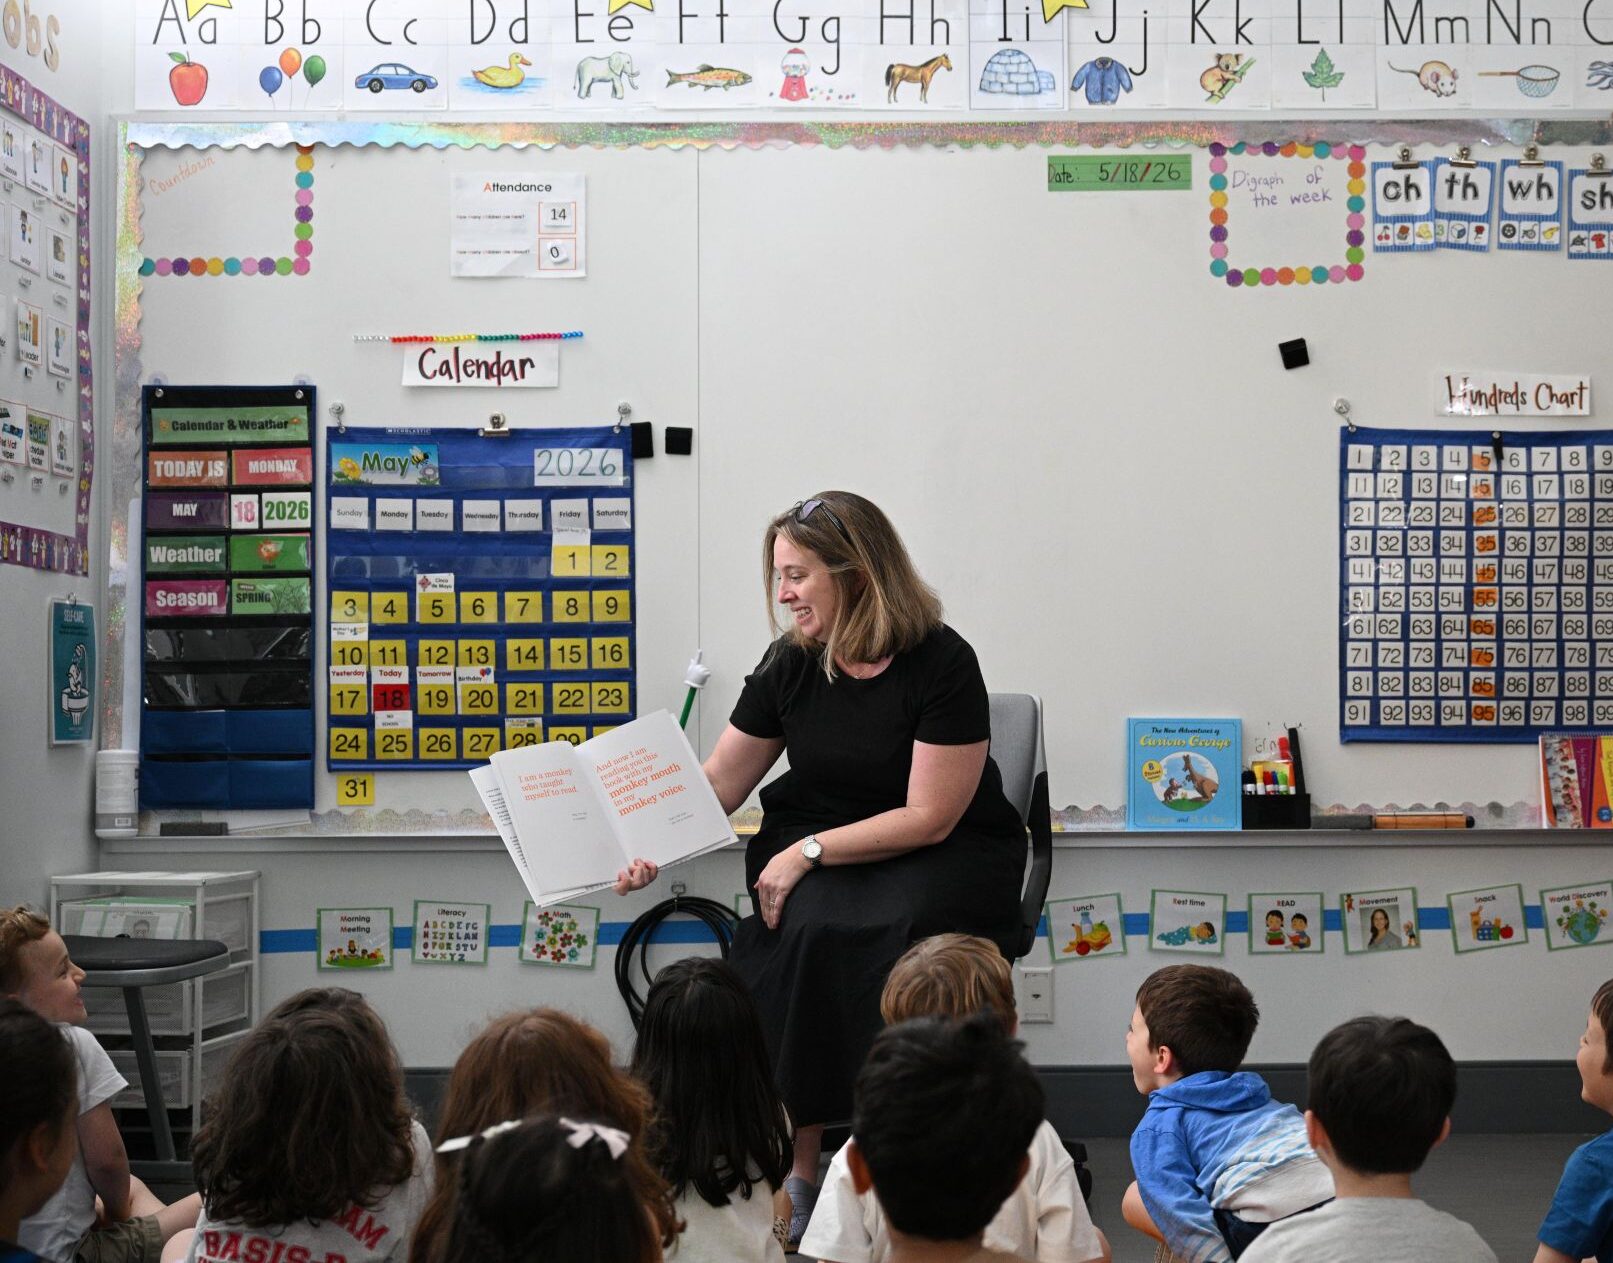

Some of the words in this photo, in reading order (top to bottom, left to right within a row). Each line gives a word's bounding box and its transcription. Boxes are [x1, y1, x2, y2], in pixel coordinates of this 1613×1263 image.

[149, 157, 215, 196] Countdown
[1048, 163, 1080, 183] Date:
[1099, 162, 1181, 183] 5/18/26
[1232, 170, 1284, 192] Digraph
[1306, 164, 1324, 184] of
[483, 182, 552, 192] Attendance
[1383, 173, 1422, 202] ch
[1445, 172, 1479, 201] th
[1508, 173, 1554, 202] wh
[1253, 193, 1278, 208] the
[1290, 188, 1332, 205] week
[1581, 182, 1613, 210] sh
[551, 208, 567, 221] 14
[550, 246, 559, 258] 0
[418, 346, 535, 386] Calendar
[1445, 375, 1527, 414] Hundreds
[1535, 381, 1588, 411] Chart
[172, 420, 224, 431] Calendar
[227, 420, 237, 430] &
[238, 420, 288, 430] Weather
[154, 460, 204, 478] TODAY
[208, 460, 224, 477] IS
[248, 460, 298, 474] MONDAY
[362, 452, 409, 477] May
[538, 448, 616, 476] 2026
[172, 503, 198, 517] MAY
[234, 501, 256, 523] 18
[264, 500, 309, 520] 2026
[380, 510, 408, 520] Monday
[421, 510, 448, 520] Tuesday
[464, 512, 499, 520] Wednesday
[508, 512, 539, 520] Thursday
[560, 510, 581, 518] Friday
[596, 510, 628, 518] Saturday
[1350, 536, 1368, 550] 31
[1378, 536, 1400, 550] 32
[1410, 536, 1431, 550] 33
[1442, 536, 1463, 550] 34
[1476, 536, 1496, 550] 35
[1507, 536, 1527, 551] 36
[1536, 536, 1556, 550] 37
[1566, 536, 1586, 550] 38
[150, 546, 222, 564] Weather
[569, 552, 576, 570] 1
[604, 553, 617, 570] 2
[156, 590, 218, 607] Season
[236, 592, 271, 603] SPRING
[344, 598, 356, 617] 3
[383, 599, 396, 617] 4
[432, 600, 444, 618] 5
[472, 599, 485, 617] 6
[517, 598, 529, 616] 7
[566, 598, 578, 616] 8
[606, 598, 618, 614] 9
[338, 647, 362, 666] 10
[378, 646, 398, 664] 11
[424, 646, 448, 664] 12
[465, 646, 489, 664] 13
[514, 646, 538, 664] 14
[557, 645, 582, 663] 15
[598, 644, 623, 662] 16
[379, 670, 402, 678] Today
[336, 690, 360, 708] 17
[380, 690, 404, 708] 18
[424, 690, 448, 708] 19
[468, 690, 493, 708] 20
[514, 690, 537, 707] 21
[558, 690, 584, 708] 22
[598, 688, 622, 706] 23
[1383, 705, 1404, 720] 92
[1412, 705, 1433, 720] 93
[1442, 705, 1464, 720] 94
[1502, 705, 1522, 720] 96
[1532, 705, 1554, 720] 97
[1565, 705, 1586, 720] 98
[336, 735, 360, 752] 24
[382, 734, 407, 752] 25
[426, 734, 452, 752] 26
[470, 734, 495, 752] 27
[512, 734, 537, 748] 28
[1139, 735, 1186, 748] Curious
[1188, 735, 1231, 752] George
[594, 760, 612, 772] And
[613, 753, 629, 764] now
[634, 746, 647, 756] am
[600, 765, 630, 782] reading
[630, 760, 644, 771] you
[643, 752, 658, 762] this
[544, 768, 573, 778] monkey
[604, 778, 622, 790] book
[624, 770, 640, 780] with
[642, 763, 654, 774] my
[610, 776, 648, 799] monkey
[650, 762, 682, 781] mouth
[345, 780, 366, 798] 31
[522, 783, 538, 792] who
[540, 778, 564, 788] taught
[525, 788, 550, 801] myself
[552, 788, 560, 796] to
[614, 798, 622, 807] in
[624, 794, 635, 804] my
[618, 794, 657, 816] monkey
[658, 784, 686, 799] voice.
[1172, 898, 1188, 906] Rest
[1189, 898, 1206, 908] time
[1276, 900, 1296, 908] READ
[1359, 896, 1398, 906] Movement
[1474, 894, 1496, 904] Snack
[1549, 894, 1570, 904] World
[1572, 890, 1608, 902] Discovery
[438, 908, 466, 918] Literacy
[552, 910, 572, 920] Math
[1072, 903, 1094, 913] Lunch
[340, 915, 371, 924] Morning
[340, 925, 371, 934] Meeting
